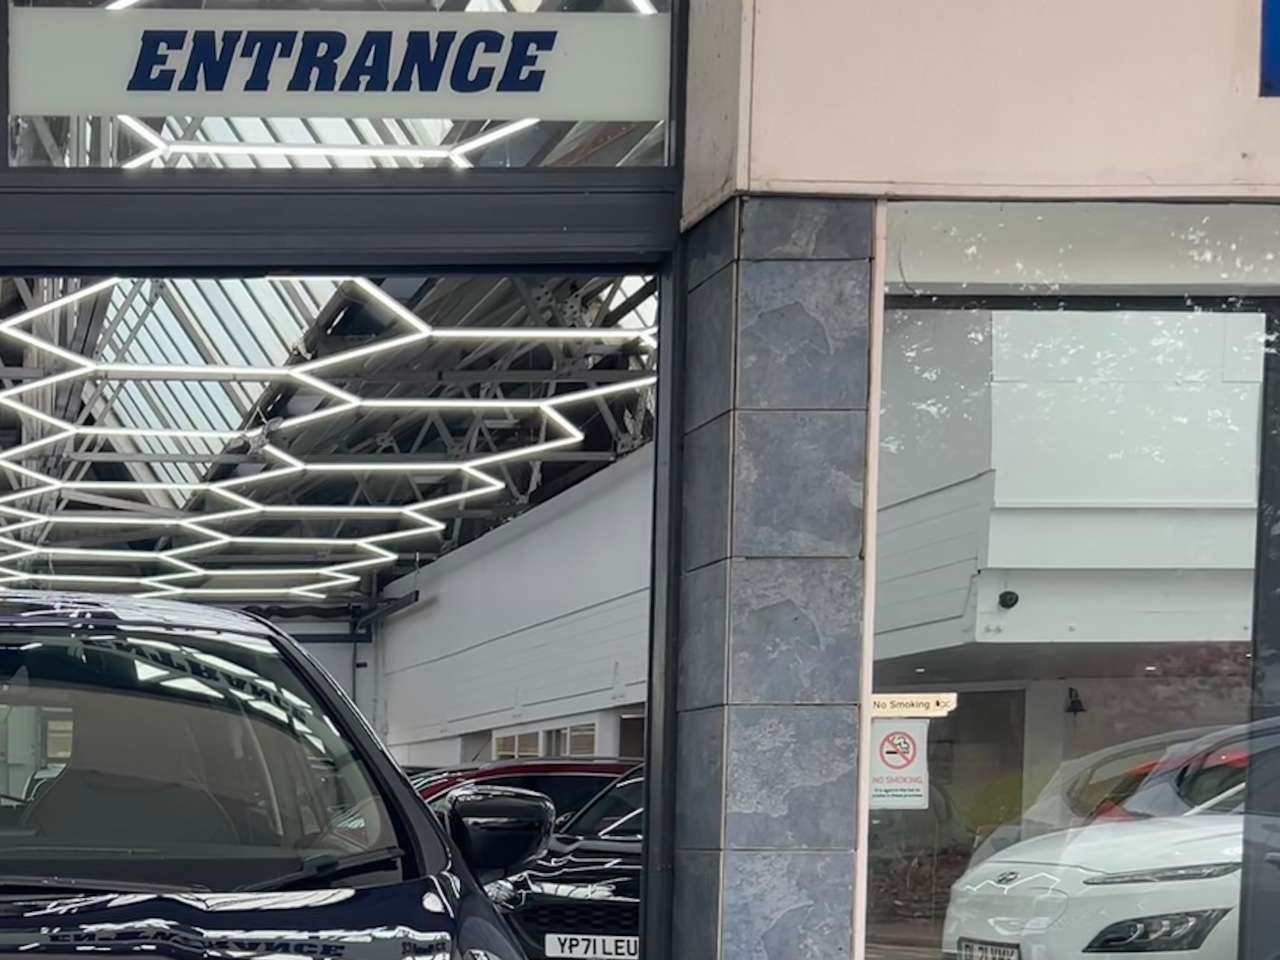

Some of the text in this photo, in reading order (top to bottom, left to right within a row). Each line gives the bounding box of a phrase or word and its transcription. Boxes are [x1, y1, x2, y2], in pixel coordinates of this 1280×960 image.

[127, 29, 557, 93] ENTRANCE
[557, 937, 638, 956] YP71 LEU
